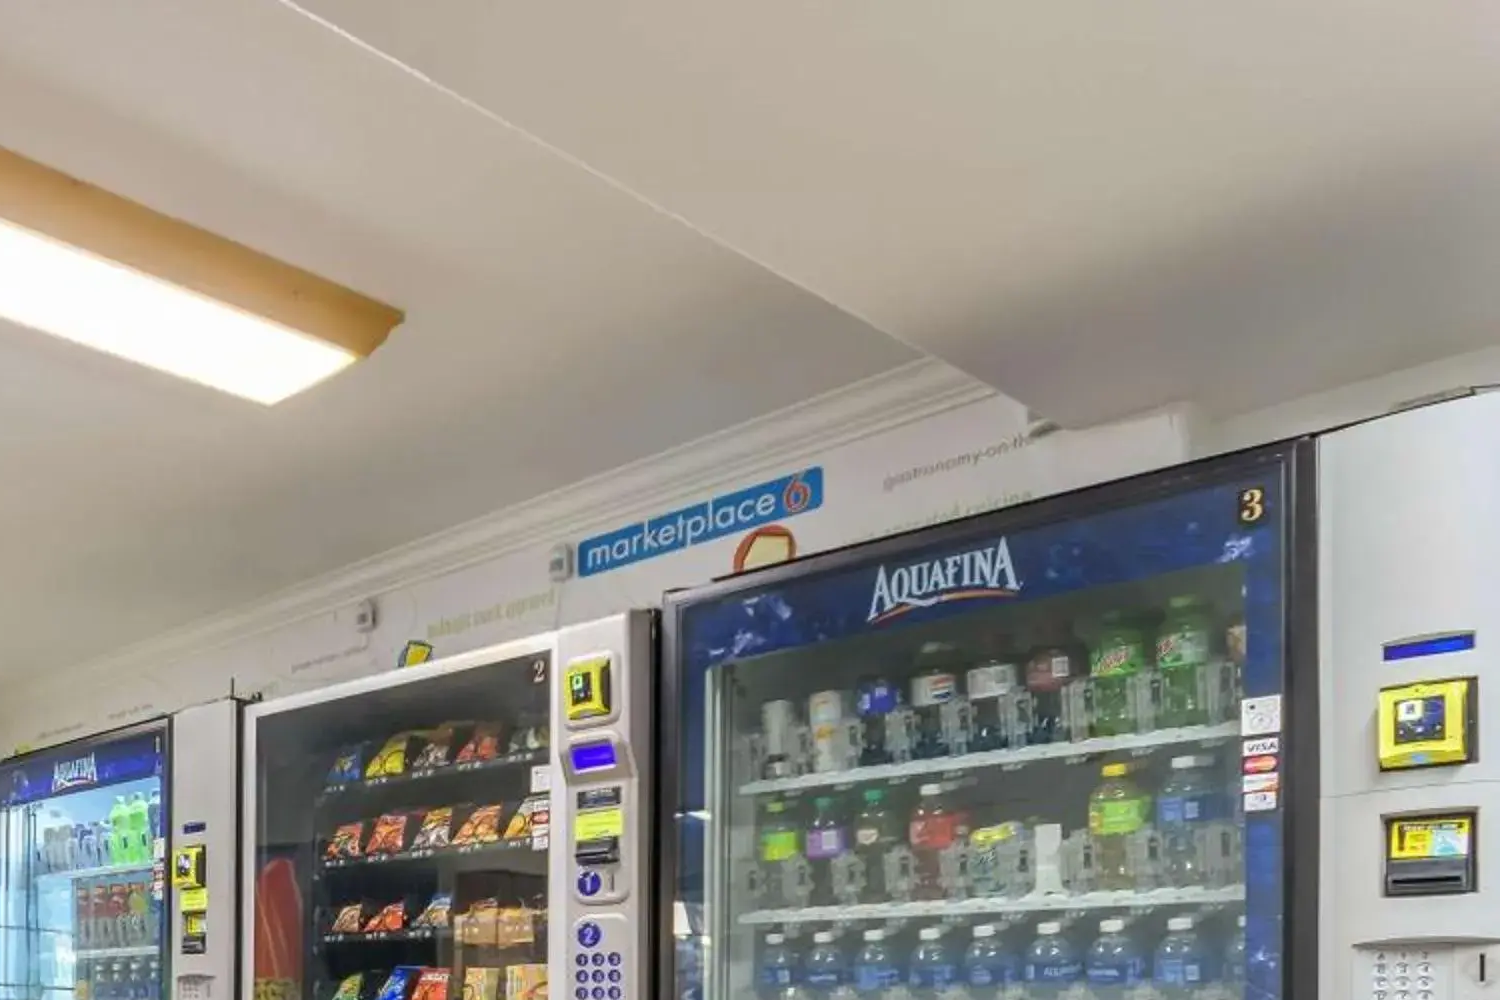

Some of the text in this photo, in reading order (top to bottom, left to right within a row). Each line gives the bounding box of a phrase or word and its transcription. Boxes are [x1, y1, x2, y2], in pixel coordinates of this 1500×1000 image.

[1241, 488, 1263, 521] 3
[586, 492, 777, 570] marketplace
[866, 535, 1022, 624] AQUAFINA
[533, 660, 545, 683] 2
[1247, 742, 1277, 753] VISA
